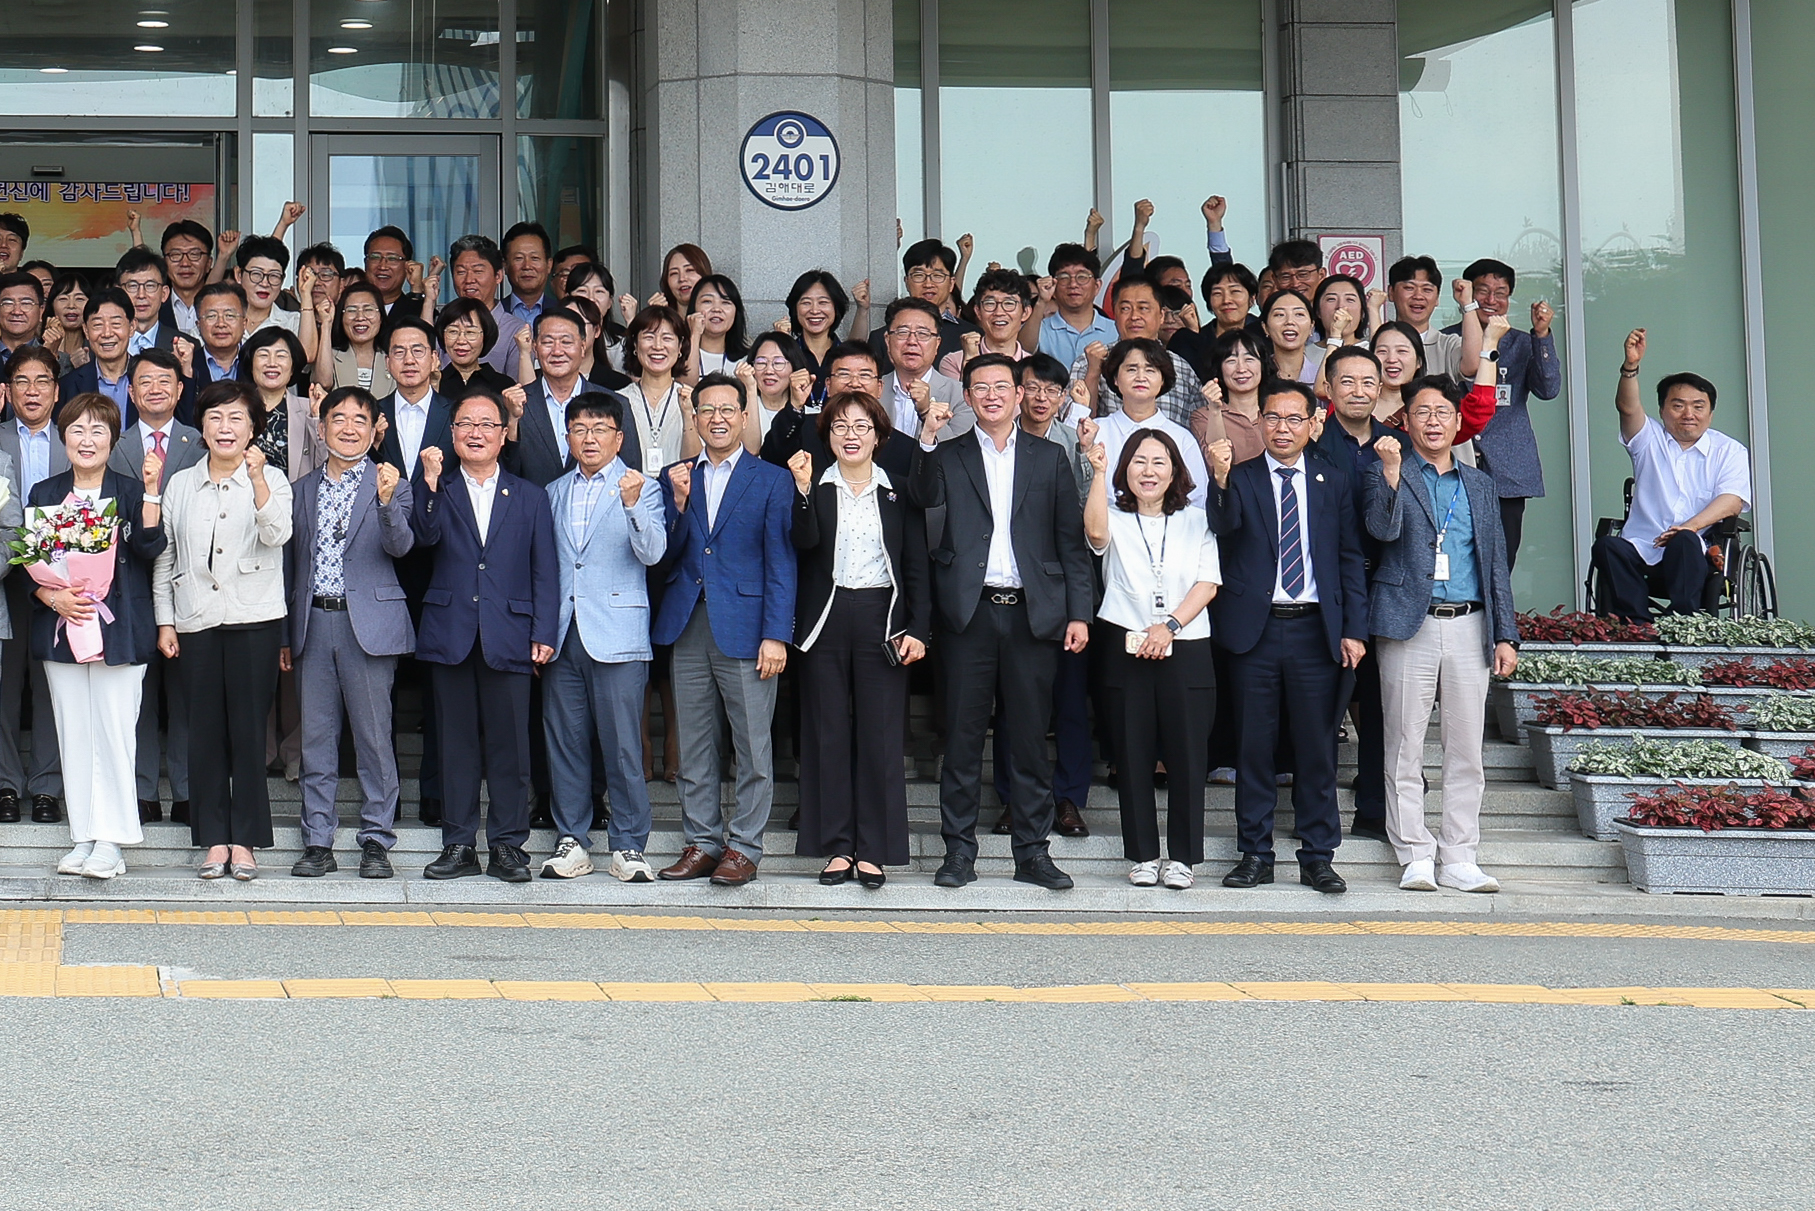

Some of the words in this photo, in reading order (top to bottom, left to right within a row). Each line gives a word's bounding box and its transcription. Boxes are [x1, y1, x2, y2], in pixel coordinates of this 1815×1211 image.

[751, 152, 830, 181] 2401
[59, 181, 190, 204] 감사드립니다!
[765, 182, 815, 194] 김해대로
[1339, 251, 1365, 260] AED
